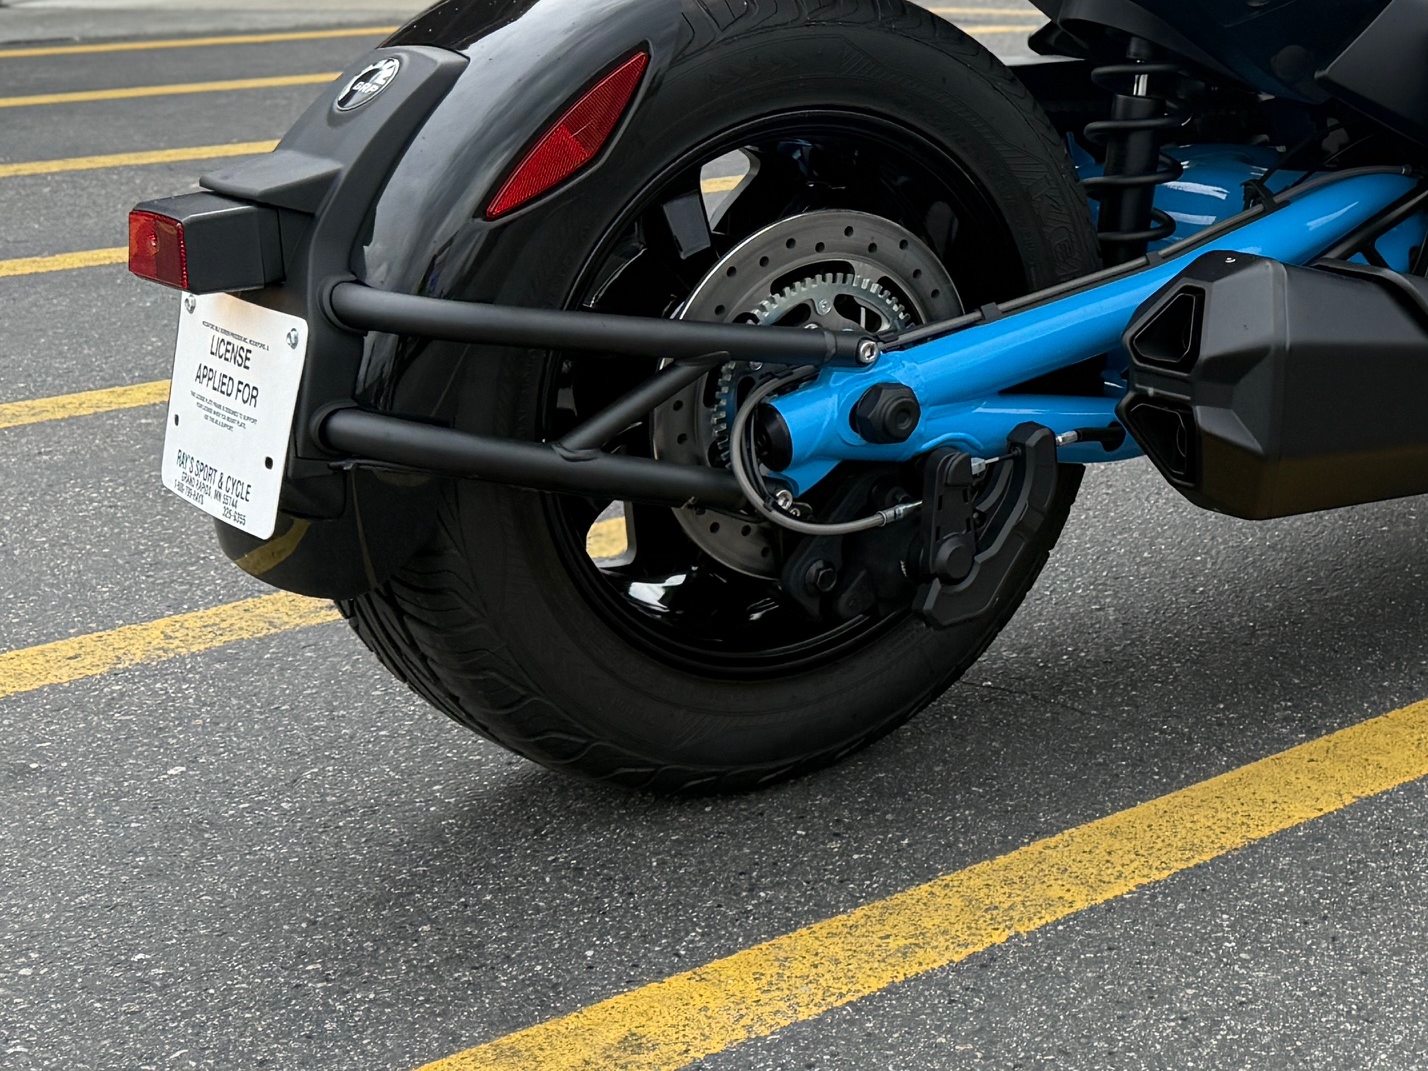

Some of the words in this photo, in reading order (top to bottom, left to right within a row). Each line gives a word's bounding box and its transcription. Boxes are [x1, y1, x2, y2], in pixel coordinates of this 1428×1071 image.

[210, 334, 252, 370] LICENSE
[195, 363, 235, 397] APPLIED
[235, 380, 259, 408] FOR
[176, 449, 194, 474] RAY'S
[195, 460, 218, 485] SPORT
[218, 472, 224, 490] &
[225, 475, 252, 502] CYCLE
